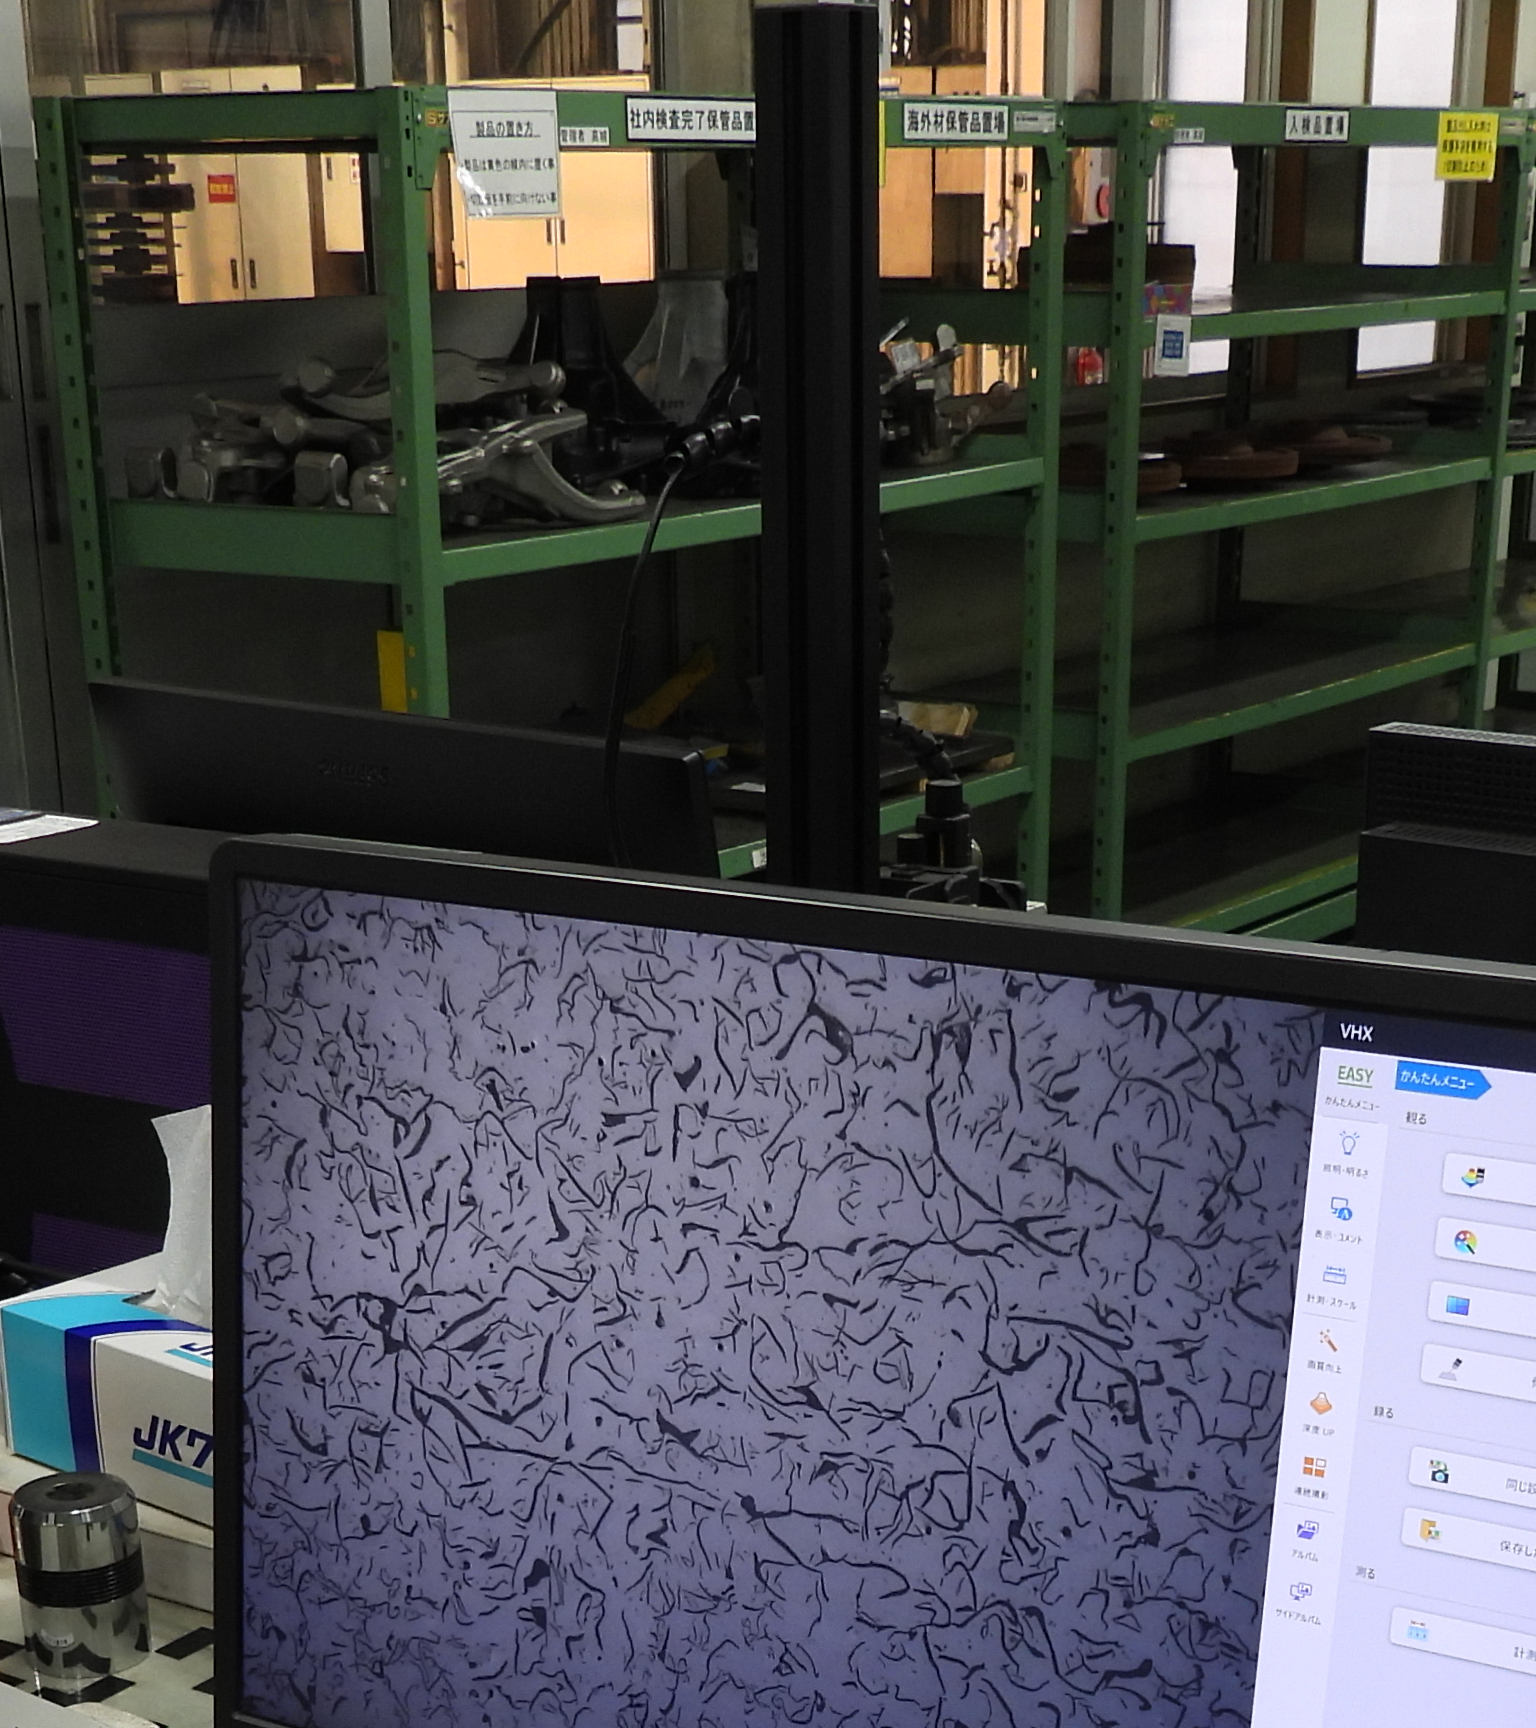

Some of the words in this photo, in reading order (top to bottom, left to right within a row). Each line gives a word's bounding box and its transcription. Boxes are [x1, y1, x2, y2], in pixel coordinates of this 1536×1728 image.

[907, 109, 1005, 134] 海外材保管品置場
[1340, 1022, 1374, 1043] VHX
[1337, 1065, 1374, 1083] EASY
[1400, 1069, 1475, 1090] かんたんメニュー
[1324, 1095, 1380, 1111] かんたんメニュー
[1405, 1110, 1427, 1125] 観る
[1373, 1405, 1394, 1420] 録る
[1356, 1565, 1376, 1580] 測る
